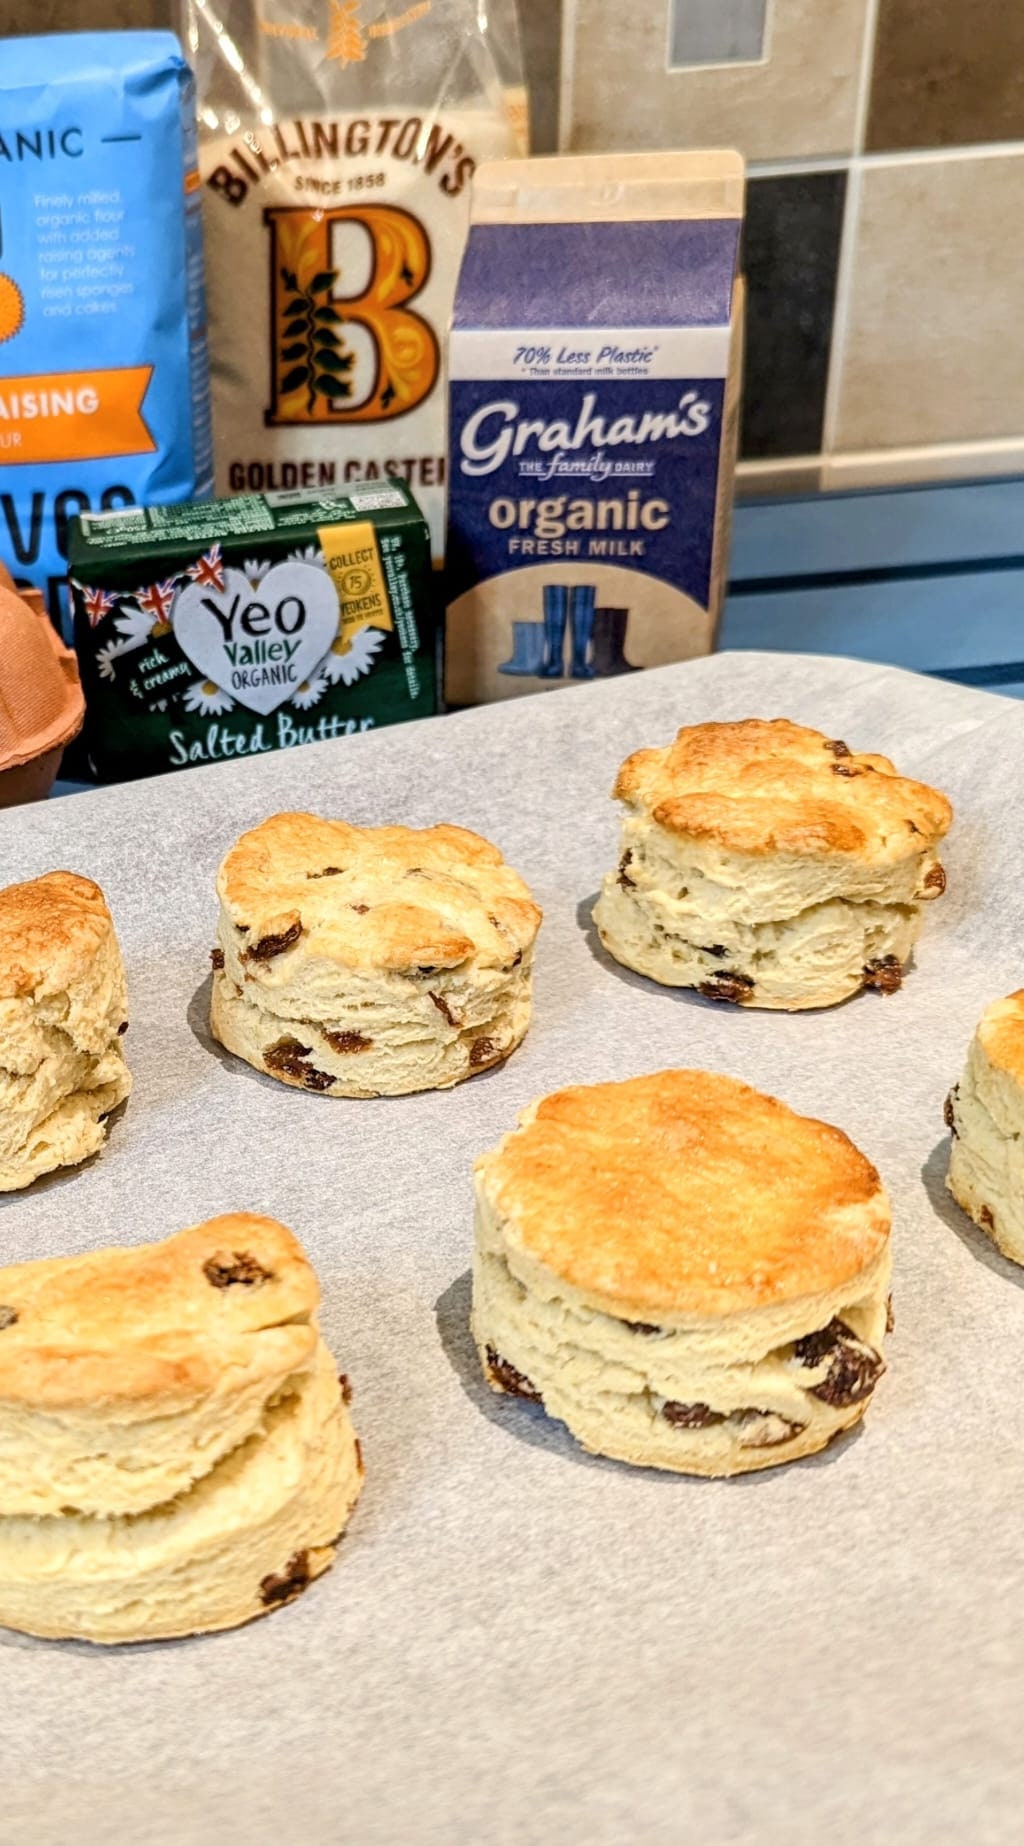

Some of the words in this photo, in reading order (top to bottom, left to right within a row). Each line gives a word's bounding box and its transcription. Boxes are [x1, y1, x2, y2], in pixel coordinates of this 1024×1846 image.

[206, 117, 476, 207] BILLINGTON'S
[294, 175, 341, 195] SINCE
[347, 173, 385, 190] 1858
[36, 211, 89, 229] organic
[94, 208, 125, 224] flour
[39, 230, 66, 244] with
[70, 227, 119, 241] added
[40, 249, 83, 264] raising
[87, 245, 135, 262] agents
[62, 265, 124, 284] perfectly
[43, 302, 72, 317] and
[263, 203, 441, 428] B
[513, 346, 551, 365] 70%
[556, 347, 590, 364] Less
[529, 367, 550, 377] Than
[553, 367, 592, 376] standard
[594, 367, 613, 376] milk
[617, 367, 648, 376] bottles
[461, 391, 711, 476] Graham's
[229, 460, 337, 492] GOLDEN
[518, 461, 544, 473] THE
[537, 450, 612, 482] family
[614, 461, 655, 473] DAIRY
[488, 489, 670, 539] organic
[329, 547, 374, 571] COLLECT
[508, 539, 580, 556] FRESH
[589, 539, 647, 557] MILK
[349, 575, 363, 589] 15
[200, 593, 306, 642] Yeo
[138, 648, 170, 673] rich
[223, 638, 303, 668] Valley
[402, 650, 414, 665] for
[129, 679, 144, 699] &
[143, 661, 193, 691] creamy
[231, 663, 298, 690] ORGANIC
[168, 722, 272, 766] Salted
[277, 713, 375, 749] Butter
